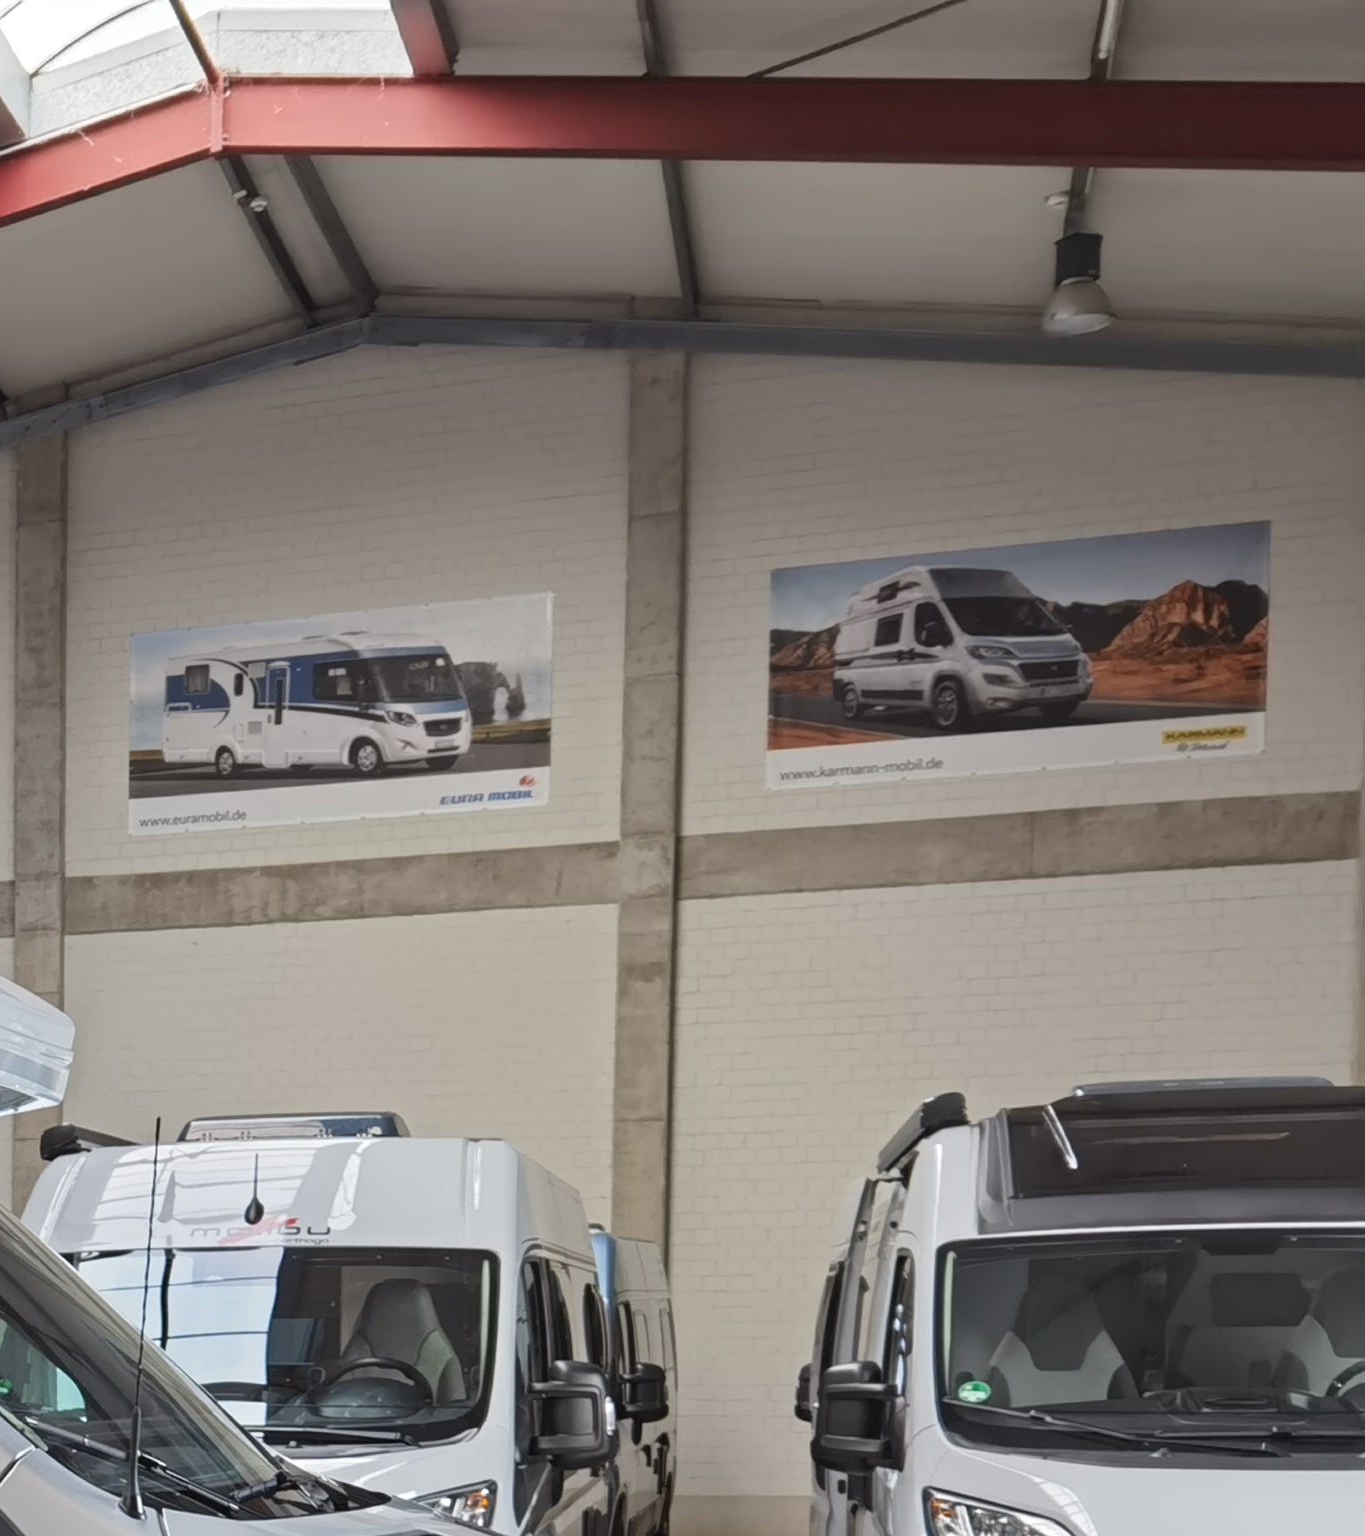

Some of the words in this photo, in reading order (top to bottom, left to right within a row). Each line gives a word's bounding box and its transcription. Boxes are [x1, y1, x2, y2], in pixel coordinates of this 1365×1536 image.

[779, 757, 944, 781] www.karmann-mobil.de
[440, 795, 485, 806] EURA
[487, 790, 534, 802] MOBIL
[138, 808, 247, 828] www.euramobil.de
